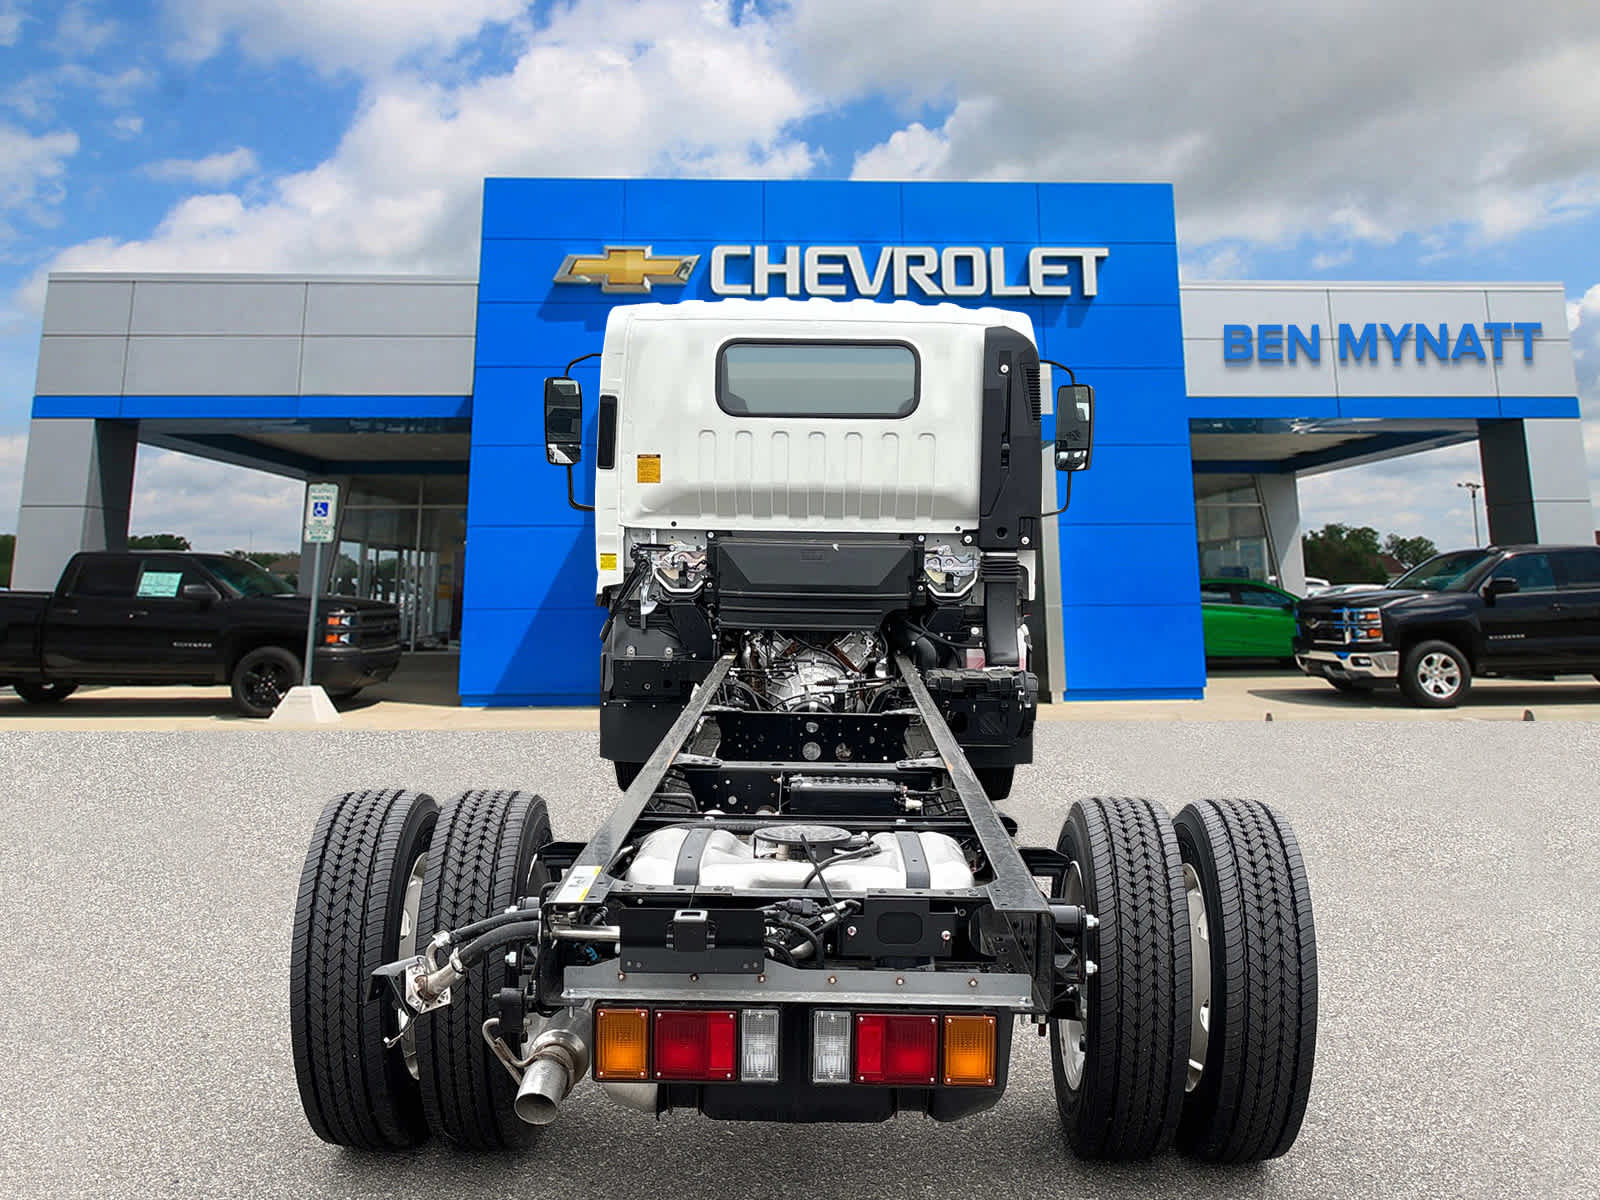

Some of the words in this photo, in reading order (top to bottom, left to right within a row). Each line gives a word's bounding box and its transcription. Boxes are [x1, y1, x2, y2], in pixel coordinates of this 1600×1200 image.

[711, 245, 1109, 296] CHEVROLET
[1223, 323, 1321, 363] BEN
[1337, 321, 1543, 363] MYNATT
